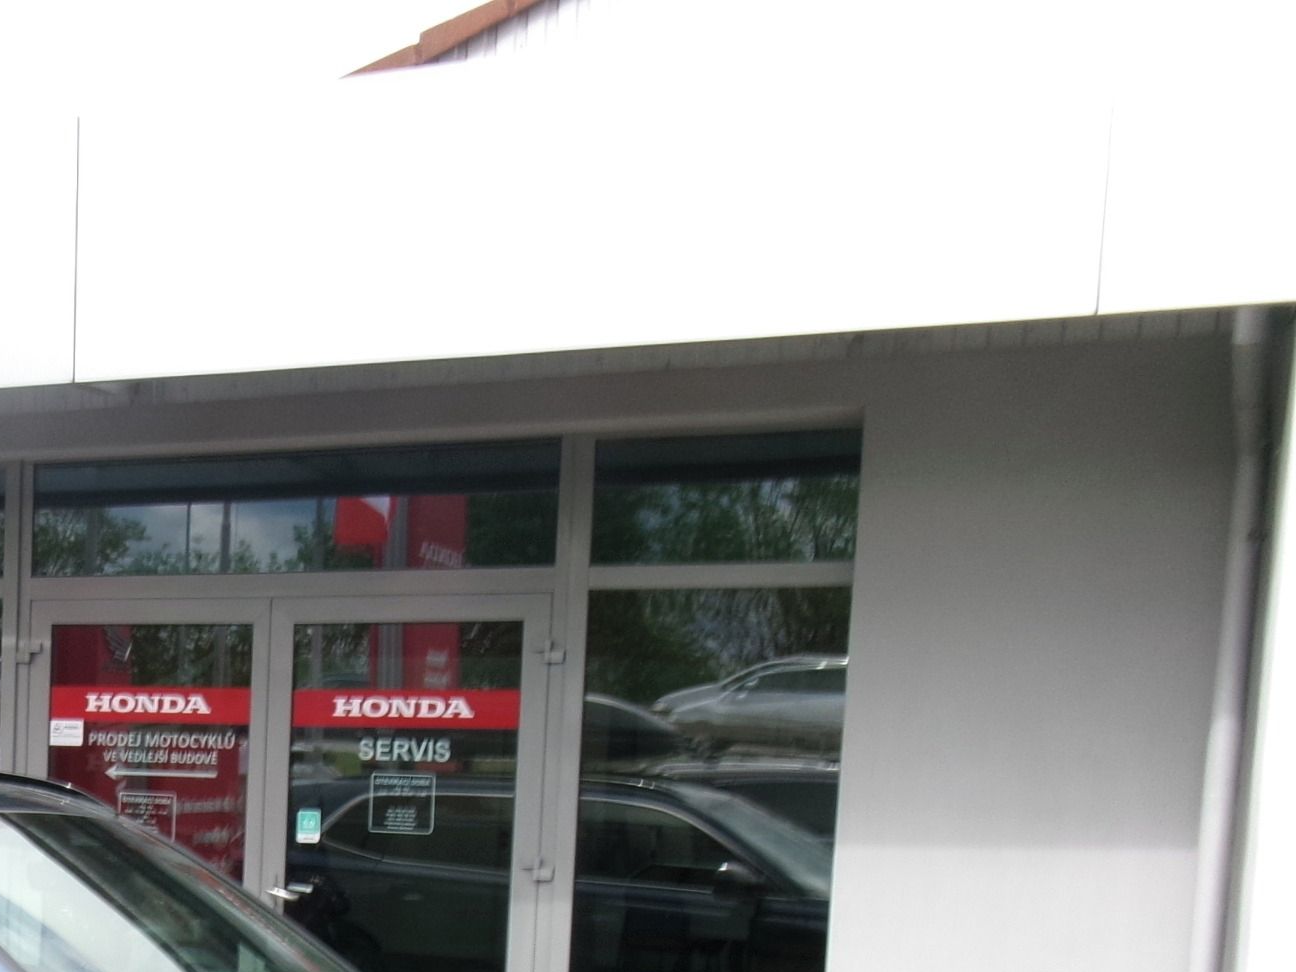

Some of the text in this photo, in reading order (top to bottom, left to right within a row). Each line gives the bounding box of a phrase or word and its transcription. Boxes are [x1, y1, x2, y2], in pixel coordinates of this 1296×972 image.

[85, 692, 211, 714] HONDA
[332, 696, 475, 719] HONDA
[88, 728, 236, 750] PRODEJ MOTOCYKLŮ
[358, 736, 451, 763] SERVIS
[104, 750, 117, 762] VE
